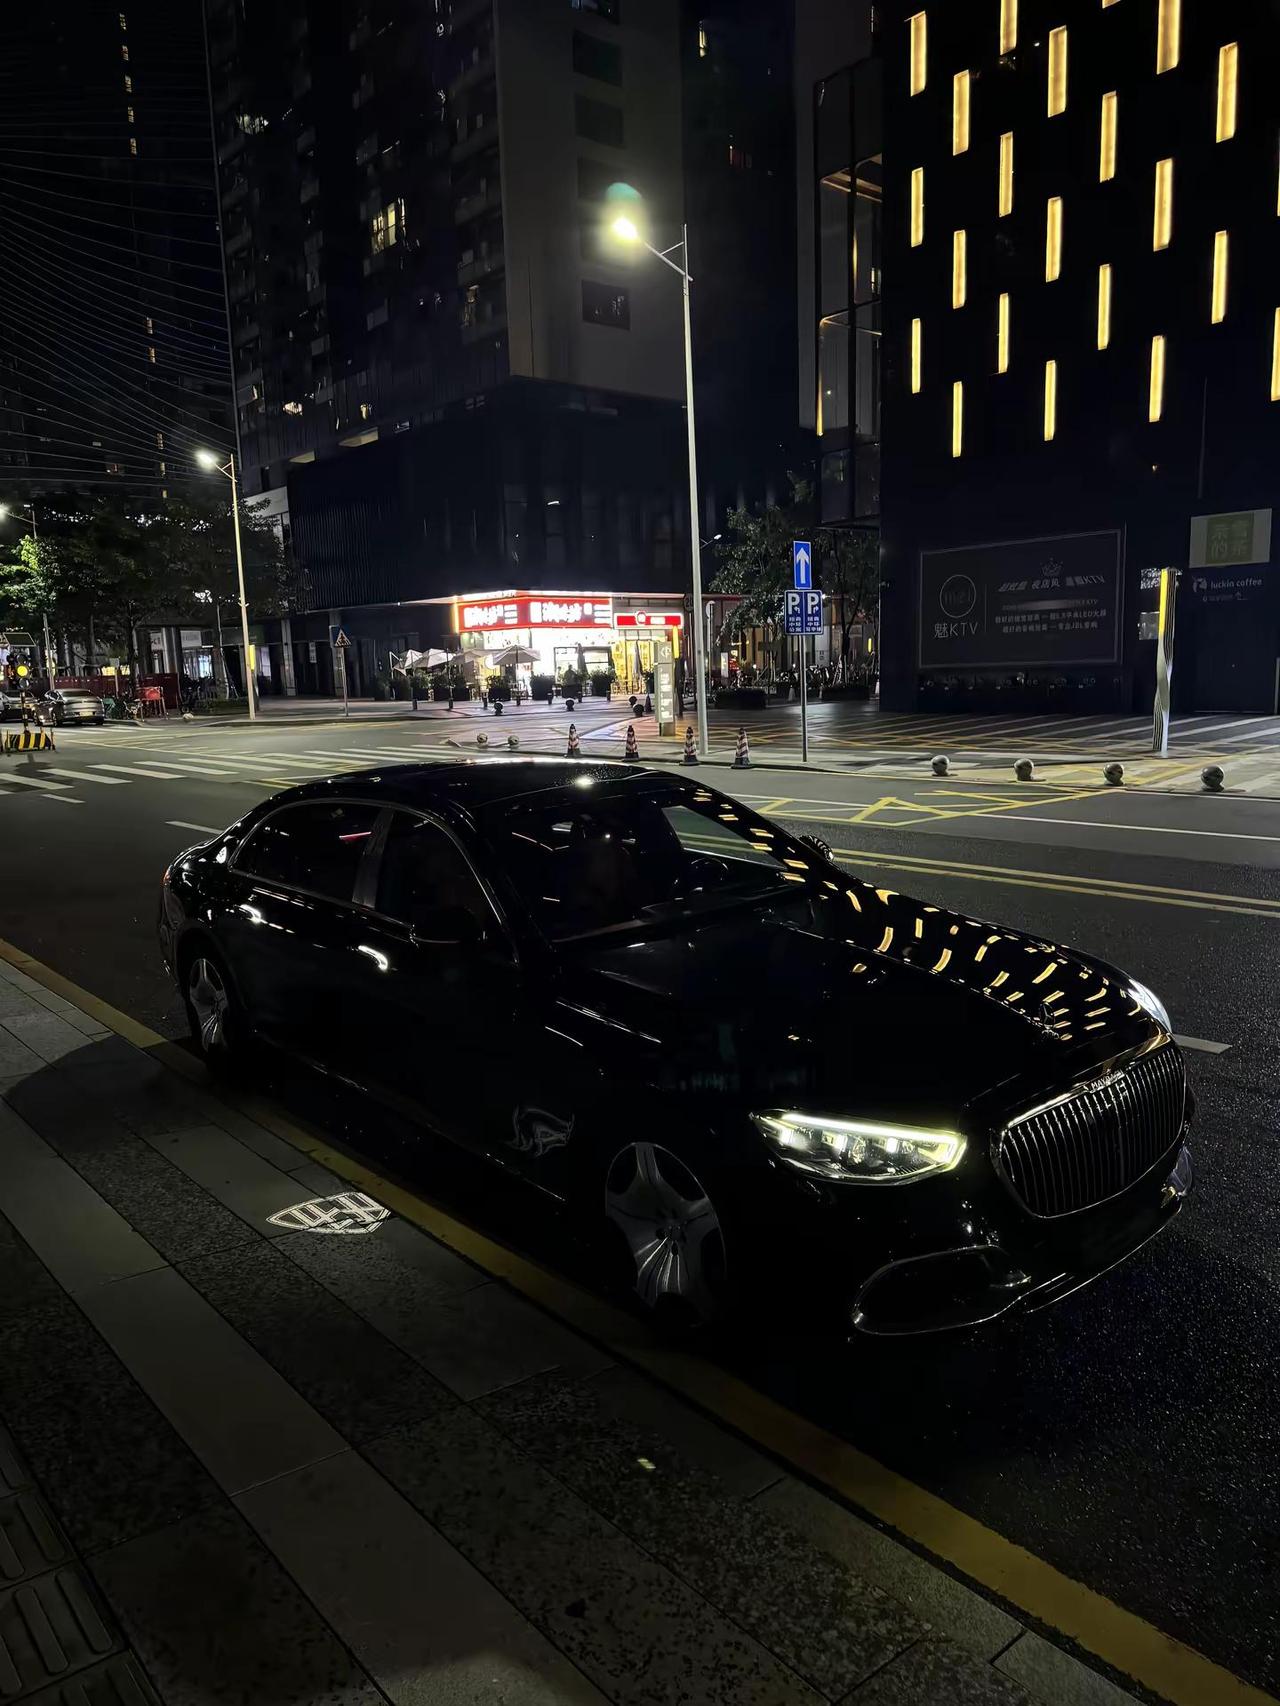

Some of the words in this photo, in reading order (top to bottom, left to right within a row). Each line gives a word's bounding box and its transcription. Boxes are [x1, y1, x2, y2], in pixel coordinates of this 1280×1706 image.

[1210, 579, 1234, 591] luckin
[1236, 577, 1262, 588] coffee
[788, 593, 800, 615] P
[807, 593, 819, 615] P
[935, 621, 978, 638] 魅KTV
